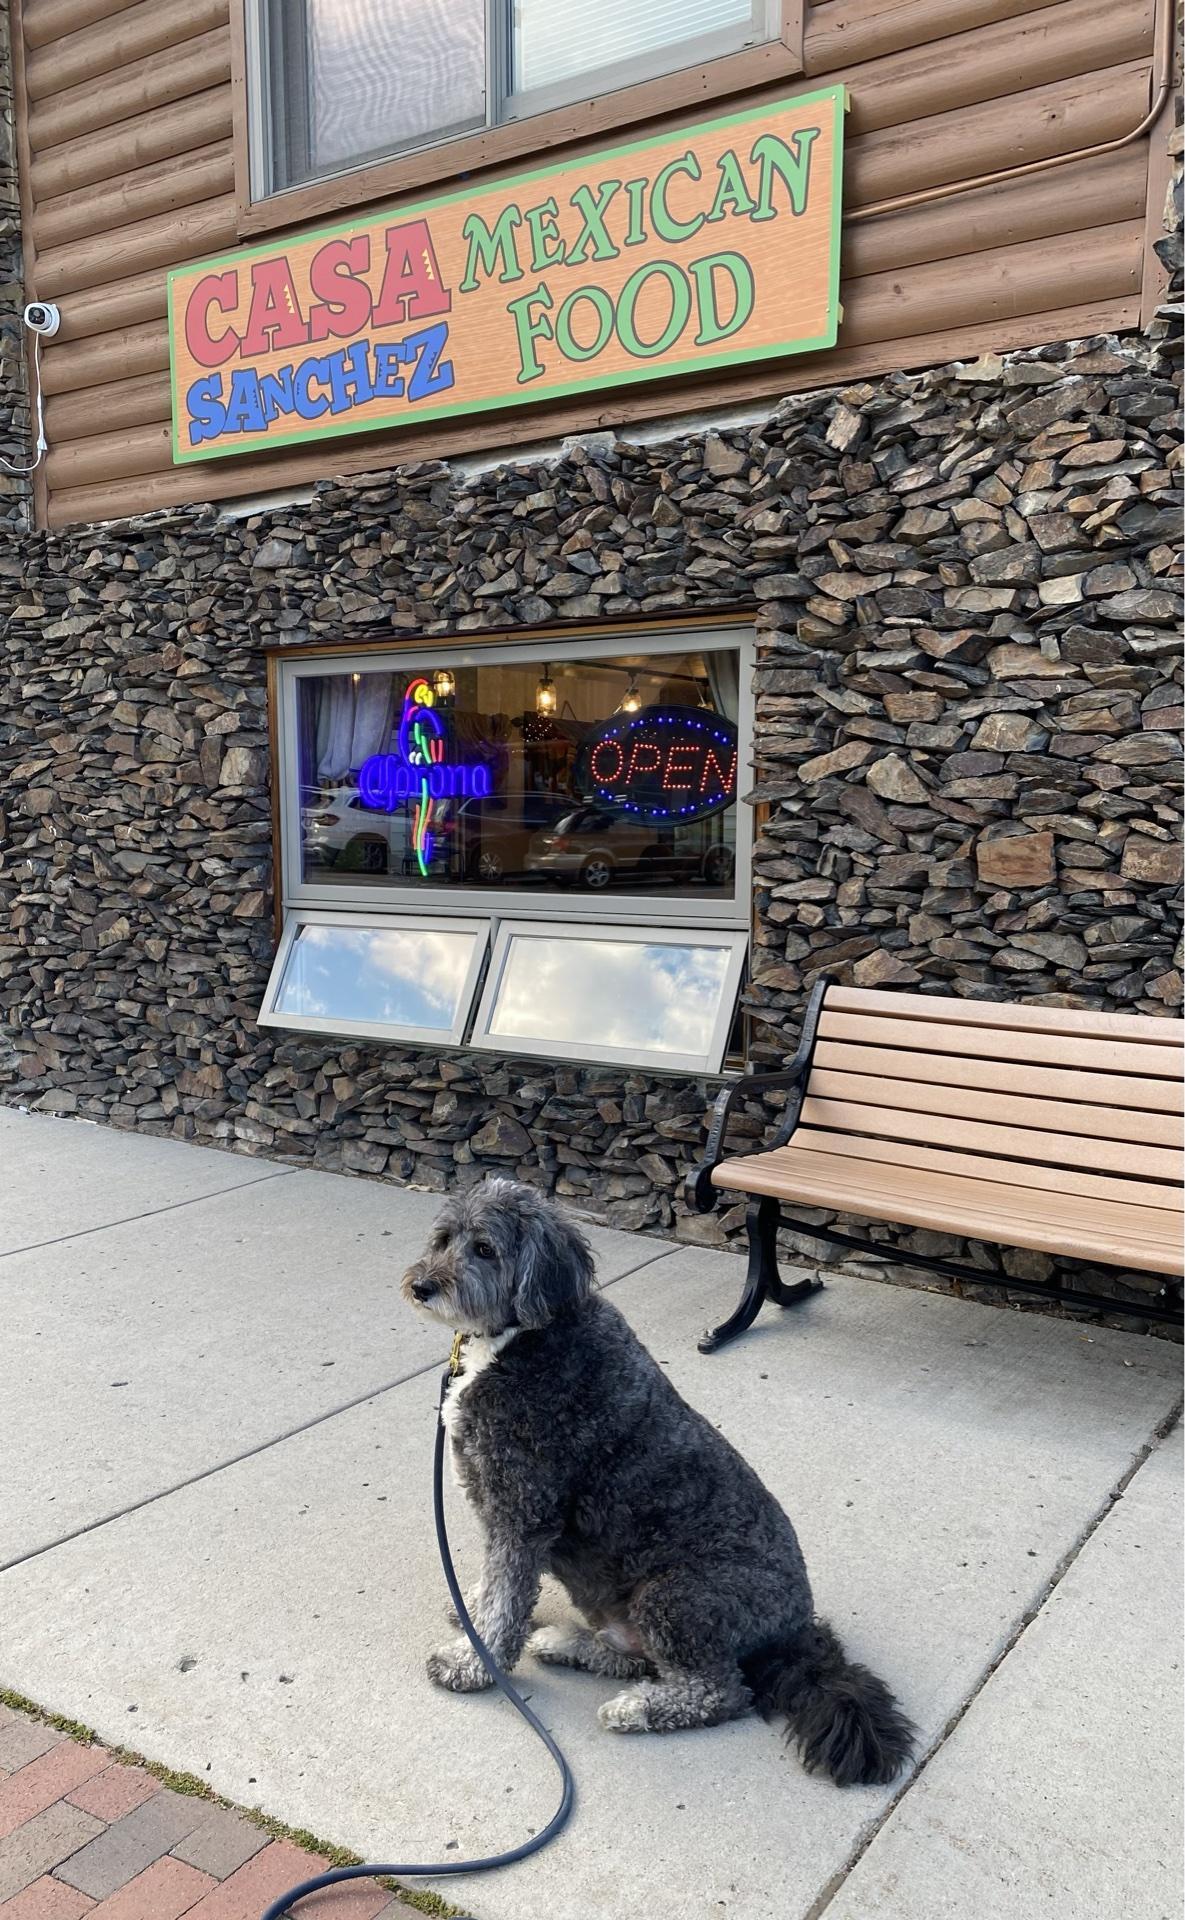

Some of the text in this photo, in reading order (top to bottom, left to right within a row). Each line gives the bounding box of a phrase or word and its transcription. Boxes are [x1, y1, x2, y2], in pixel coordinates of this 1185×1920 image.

[459, 126, 821, 293] MEXICAN
[185, 218, 451, 366] CASA
[507, 250, 755, 384] FOOD
[186, 321, 454, 445] SANCHEZ
[359, 754, 492, 813] Corona
[591, 740, 737, 795] OPEN
